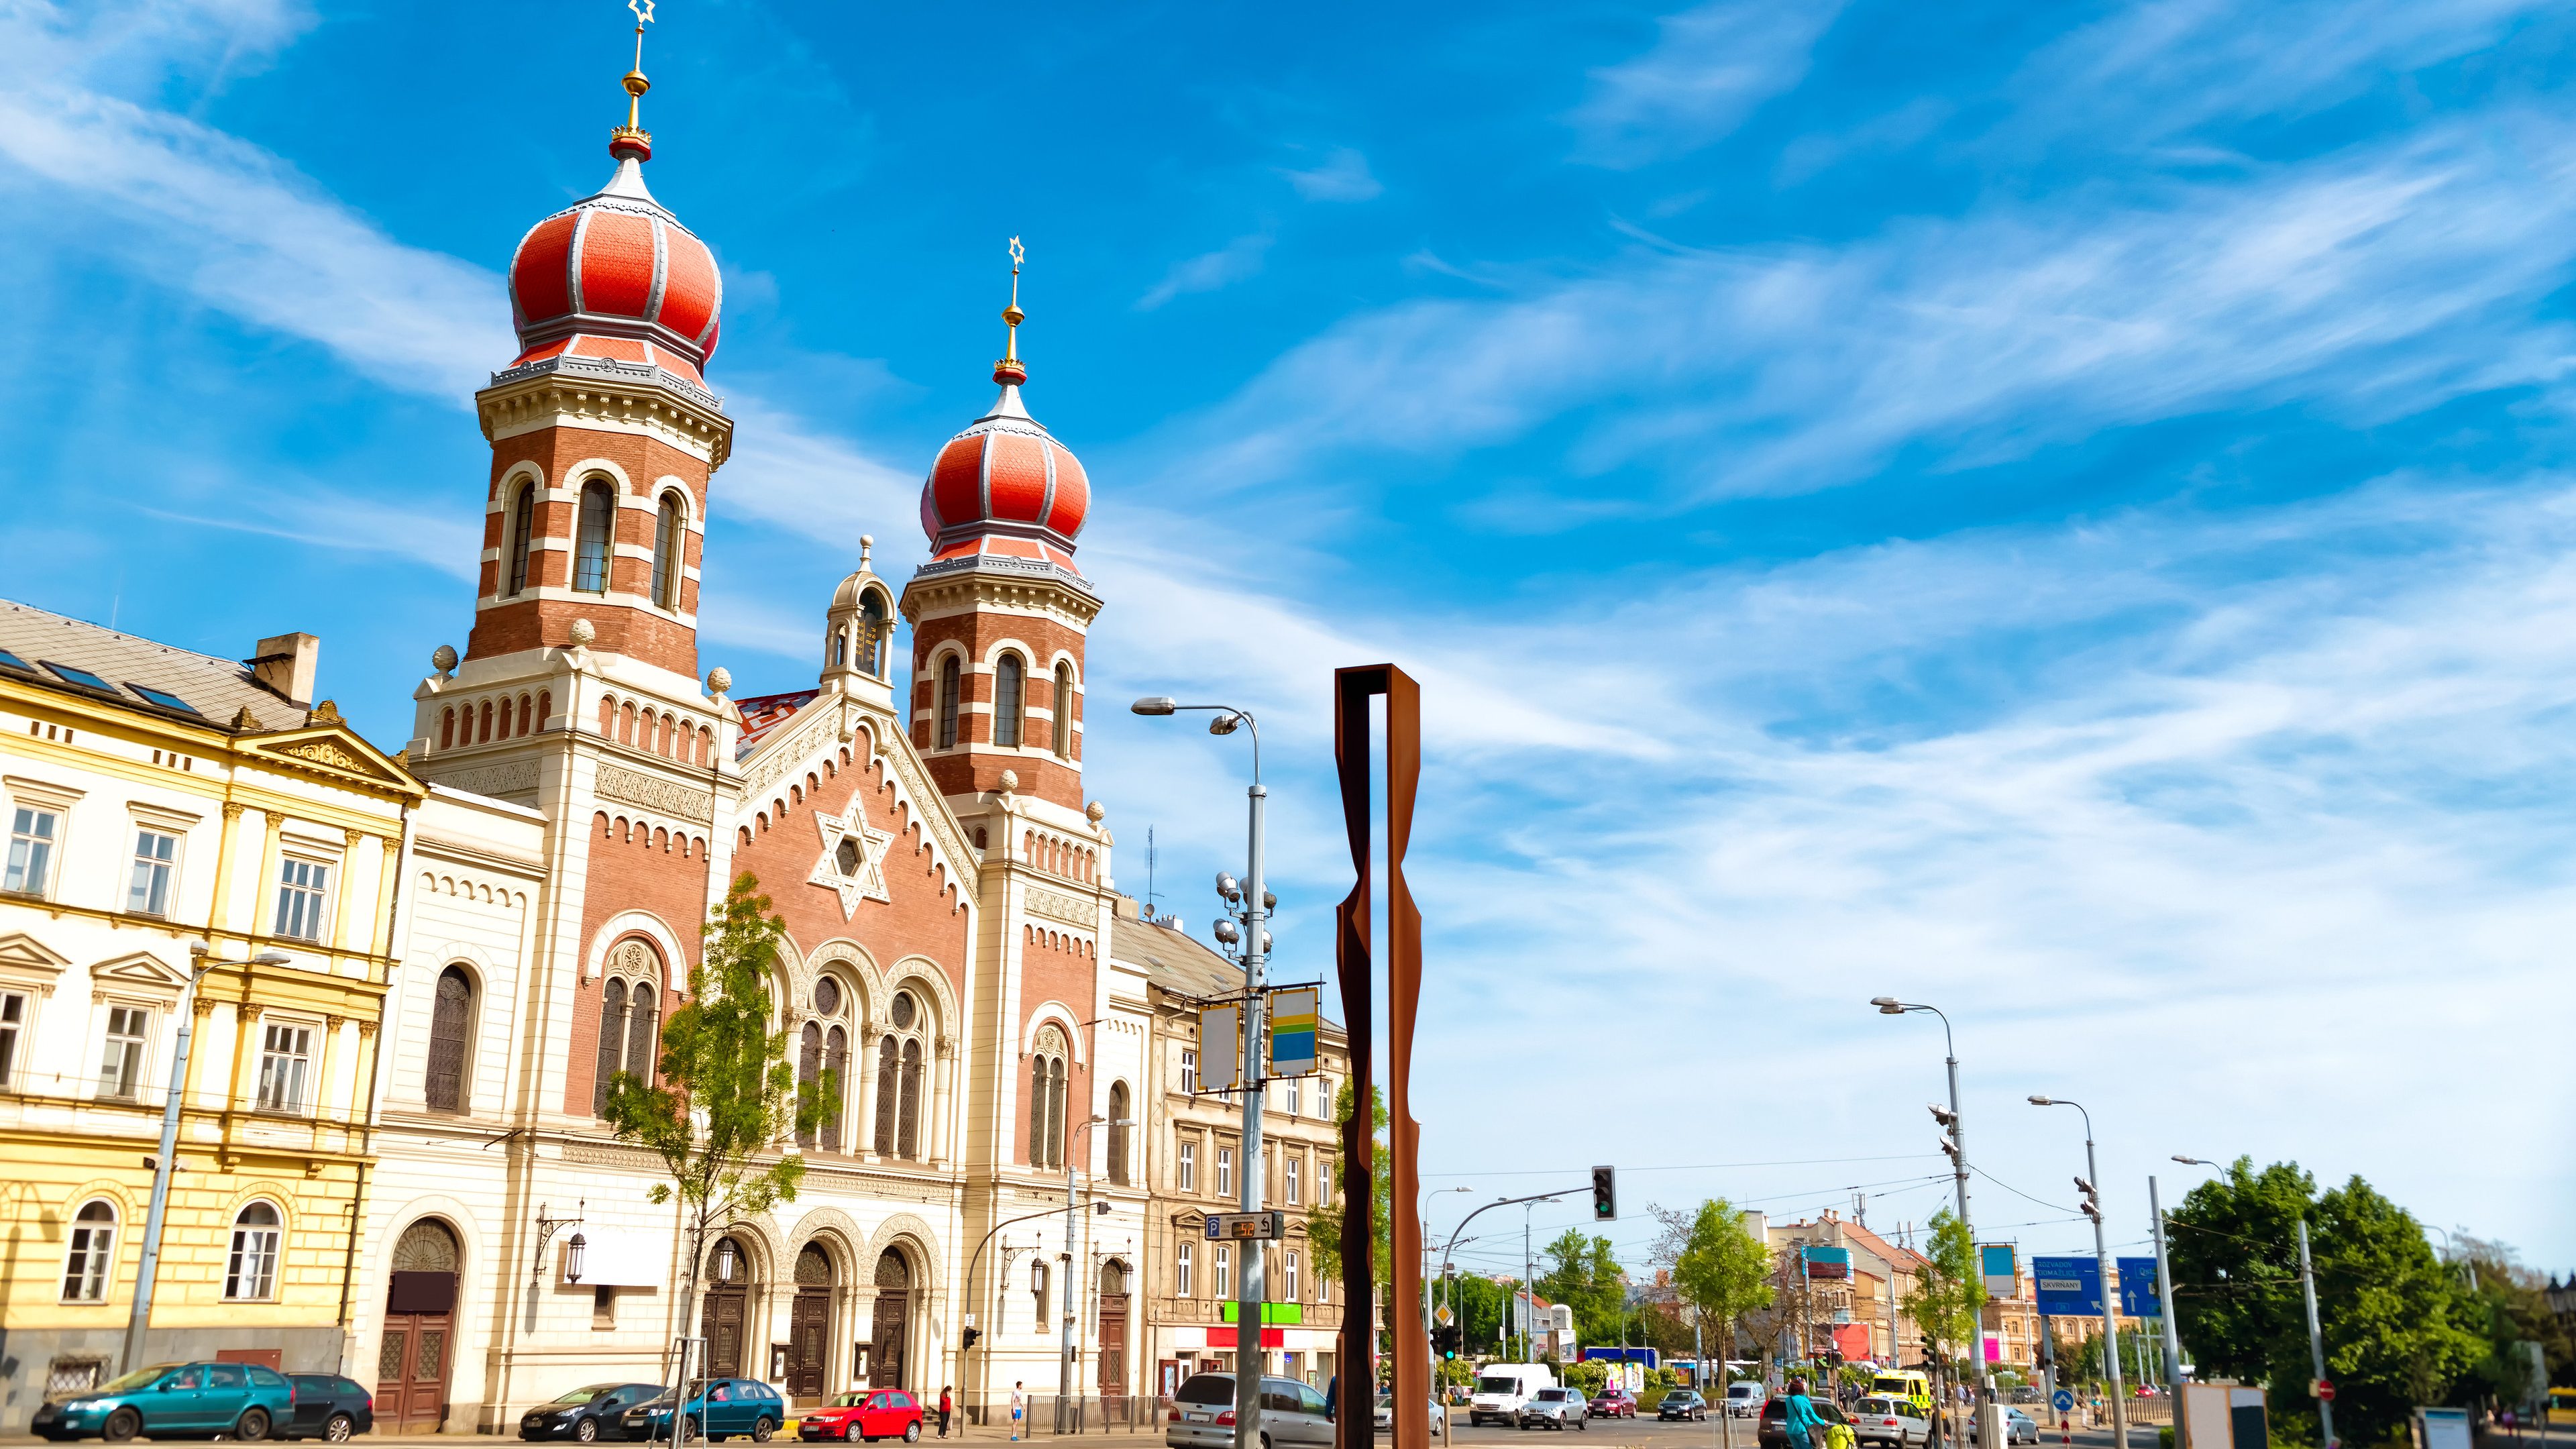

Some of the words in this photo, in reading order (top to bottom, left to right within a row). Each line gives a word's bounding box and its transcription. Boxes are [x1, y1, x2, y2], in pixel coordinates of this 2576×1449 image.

[1211, 1224, 1217, 1236] P
[1241, 1223, 1254, 1236] 52
[2038, 1269, 2078, 1277] DOMAŽLICE
